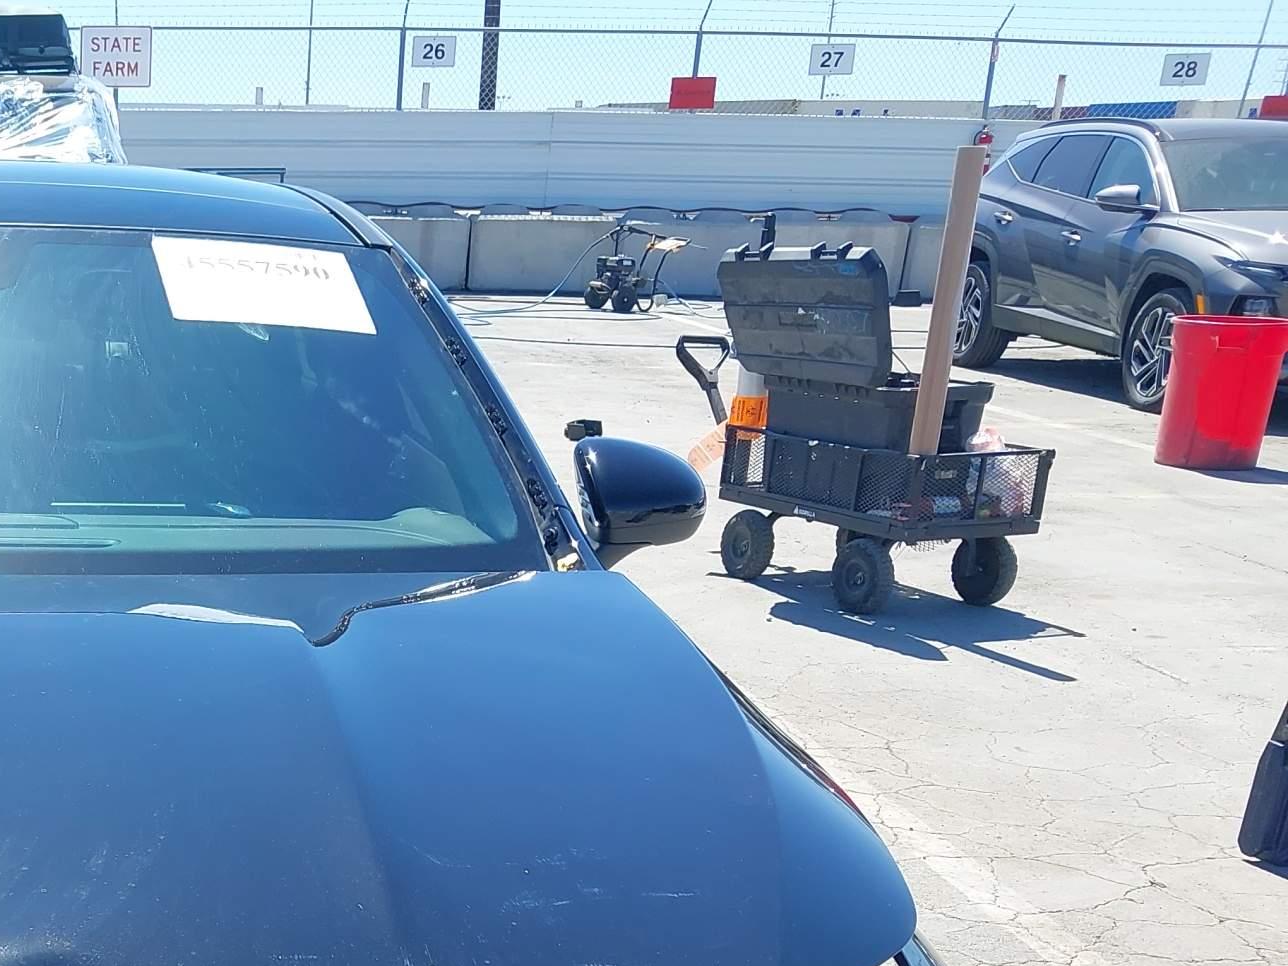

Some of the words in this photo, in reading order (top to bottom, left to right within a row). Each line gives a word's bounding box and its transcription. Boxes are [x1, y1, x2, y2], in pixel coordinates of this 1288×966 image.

[90, 36, 142, 53] STATE
[422, 43, 446, 60] 26
[819, 51, 845, 68] 27
[92, 60, 139, 77] FARM
[1171, 60, 1198, 78] 28
